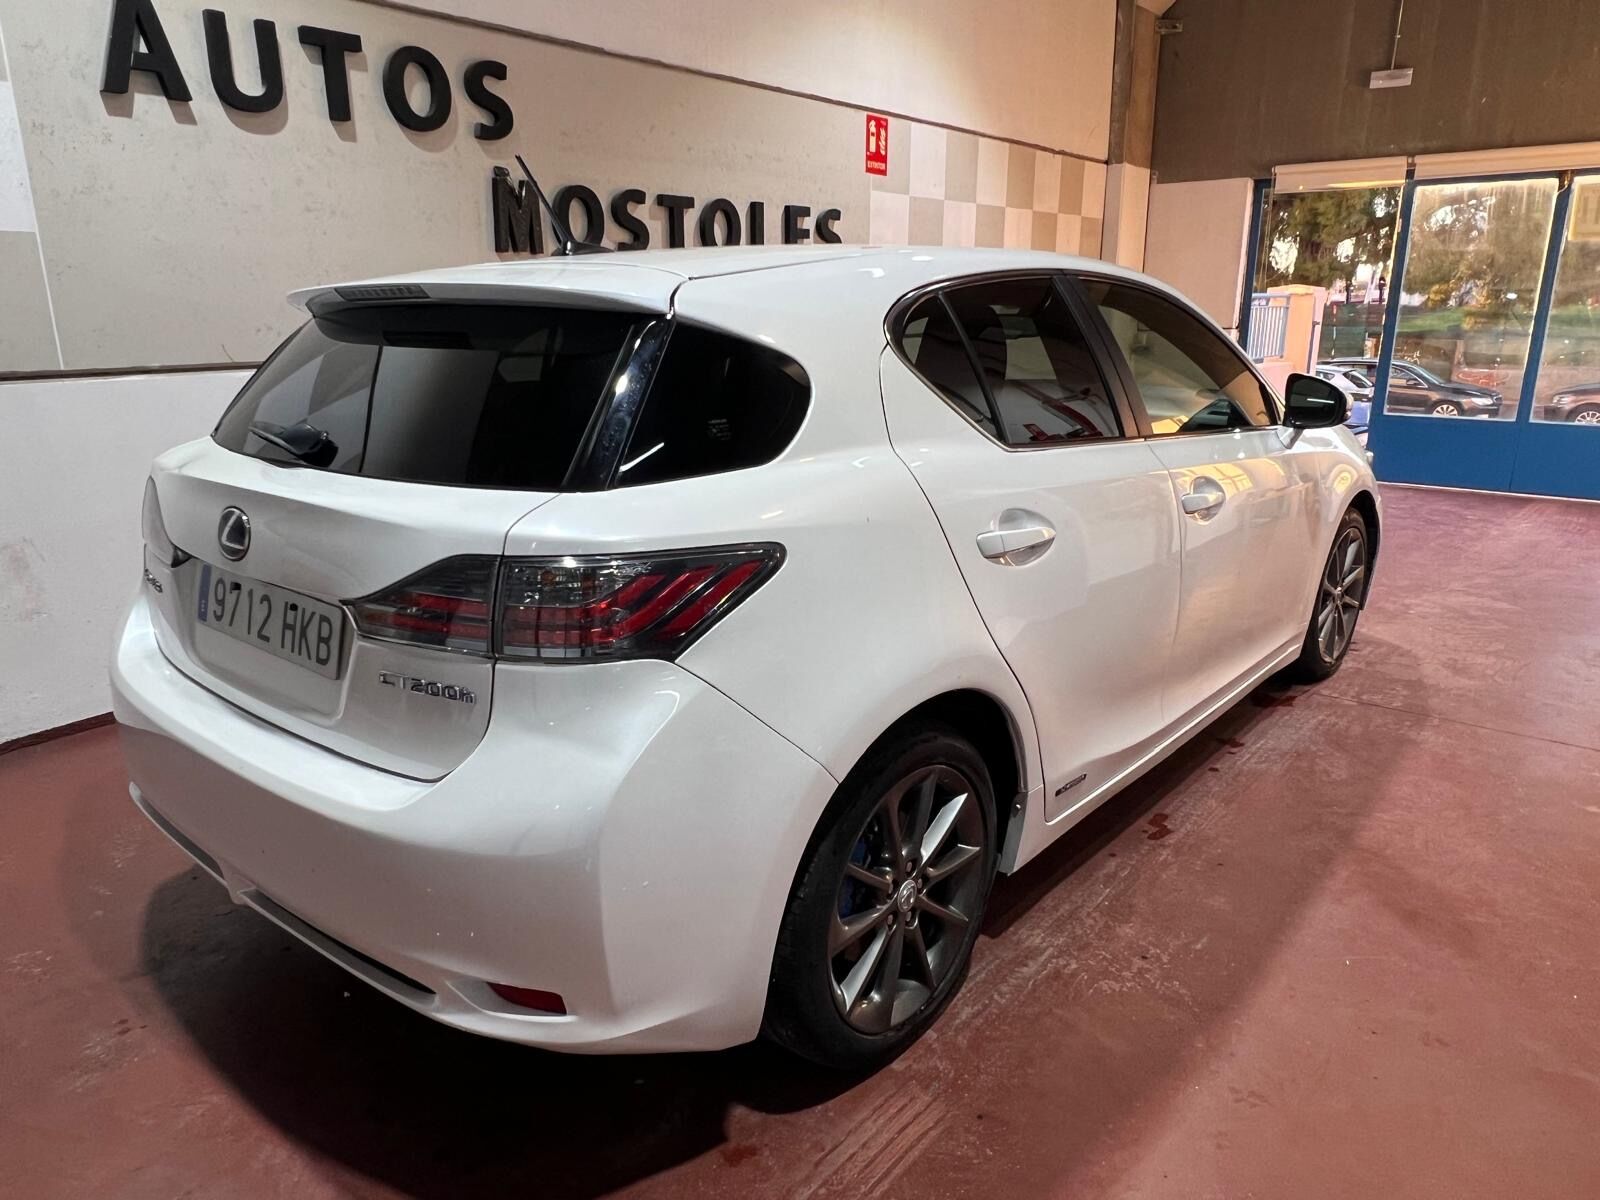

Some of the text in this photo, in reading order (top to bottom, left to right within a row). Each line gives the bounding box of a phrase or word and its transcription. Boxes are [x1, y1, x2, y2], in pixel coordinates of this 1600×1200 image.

[100, 0, 514, 141] AUTOS
[213, 577, 333, 666] 9712 HKB
